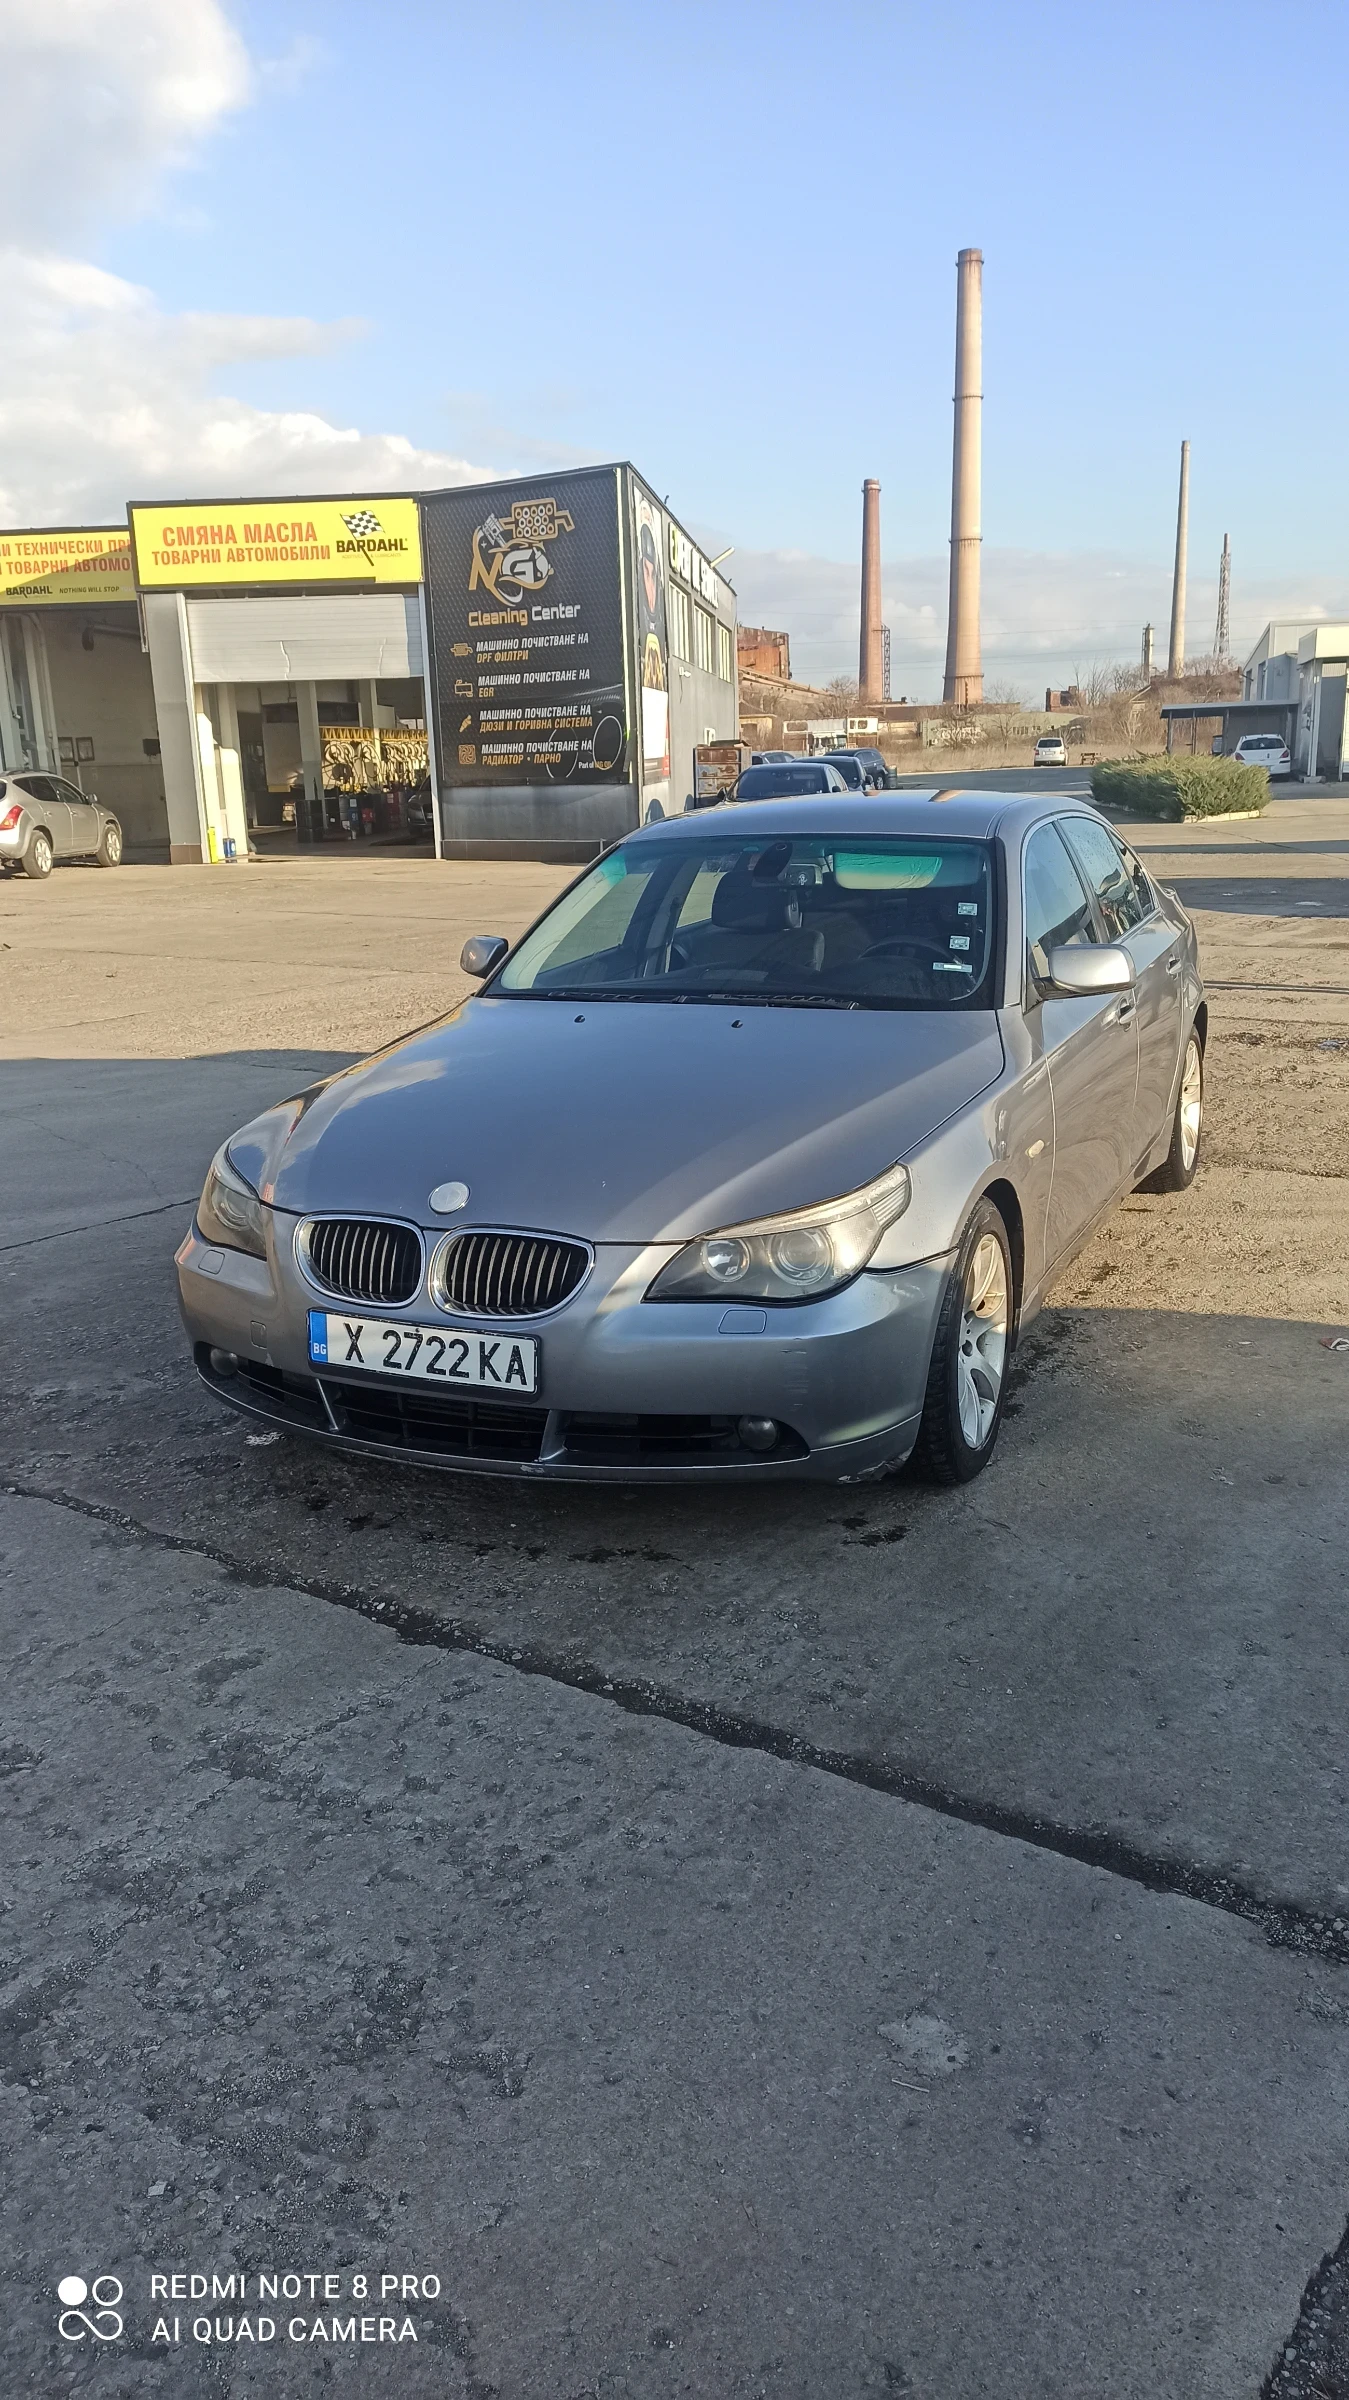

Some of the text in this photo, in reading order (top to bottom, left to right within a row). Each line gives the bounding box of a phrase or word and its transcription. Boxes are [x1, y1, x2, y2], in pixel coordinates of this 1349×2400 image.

[162, 521, 317, 546] СМЯНА МАСЛА
[15, 539, 104, 556] ТЕХНИЧЕСКИ
[151, 545, 331, 566] ТОВАРНИ АВТОМОБИЛИ
[336, 538, 408, 557] BARDAHL
[6, 559, 69, 575] ТОВАРНИ
[6, 586, 53, 597] BARDAHL
[468, 603, 581, 627] Cleaning Center
[476, 632, 589, 652] МАШИННО ПОЧИСТВАНЕ НА
[476, 650, 529, 664] DPF ФИЛТРИ
[477, 668, 590, 686] МАШИННО ПОЧИСТВАНЕ НА
[478, 687, 495, 698] EGR
[479, 704, 592, 720] МАШИННО ПОЧИСТВАНЕ НА
[479, 716, 593, 733] ДЮЗИ И ГОРИВНА СИСТЕМА
[481, 739, 593, 754] МАШИННО ПОЧИСТВАНЕ НА
[482, 753, 561, 766] РАДИАТОР ПАРНО
[313, 1322, 527, 1385] BG X 2722 KA
